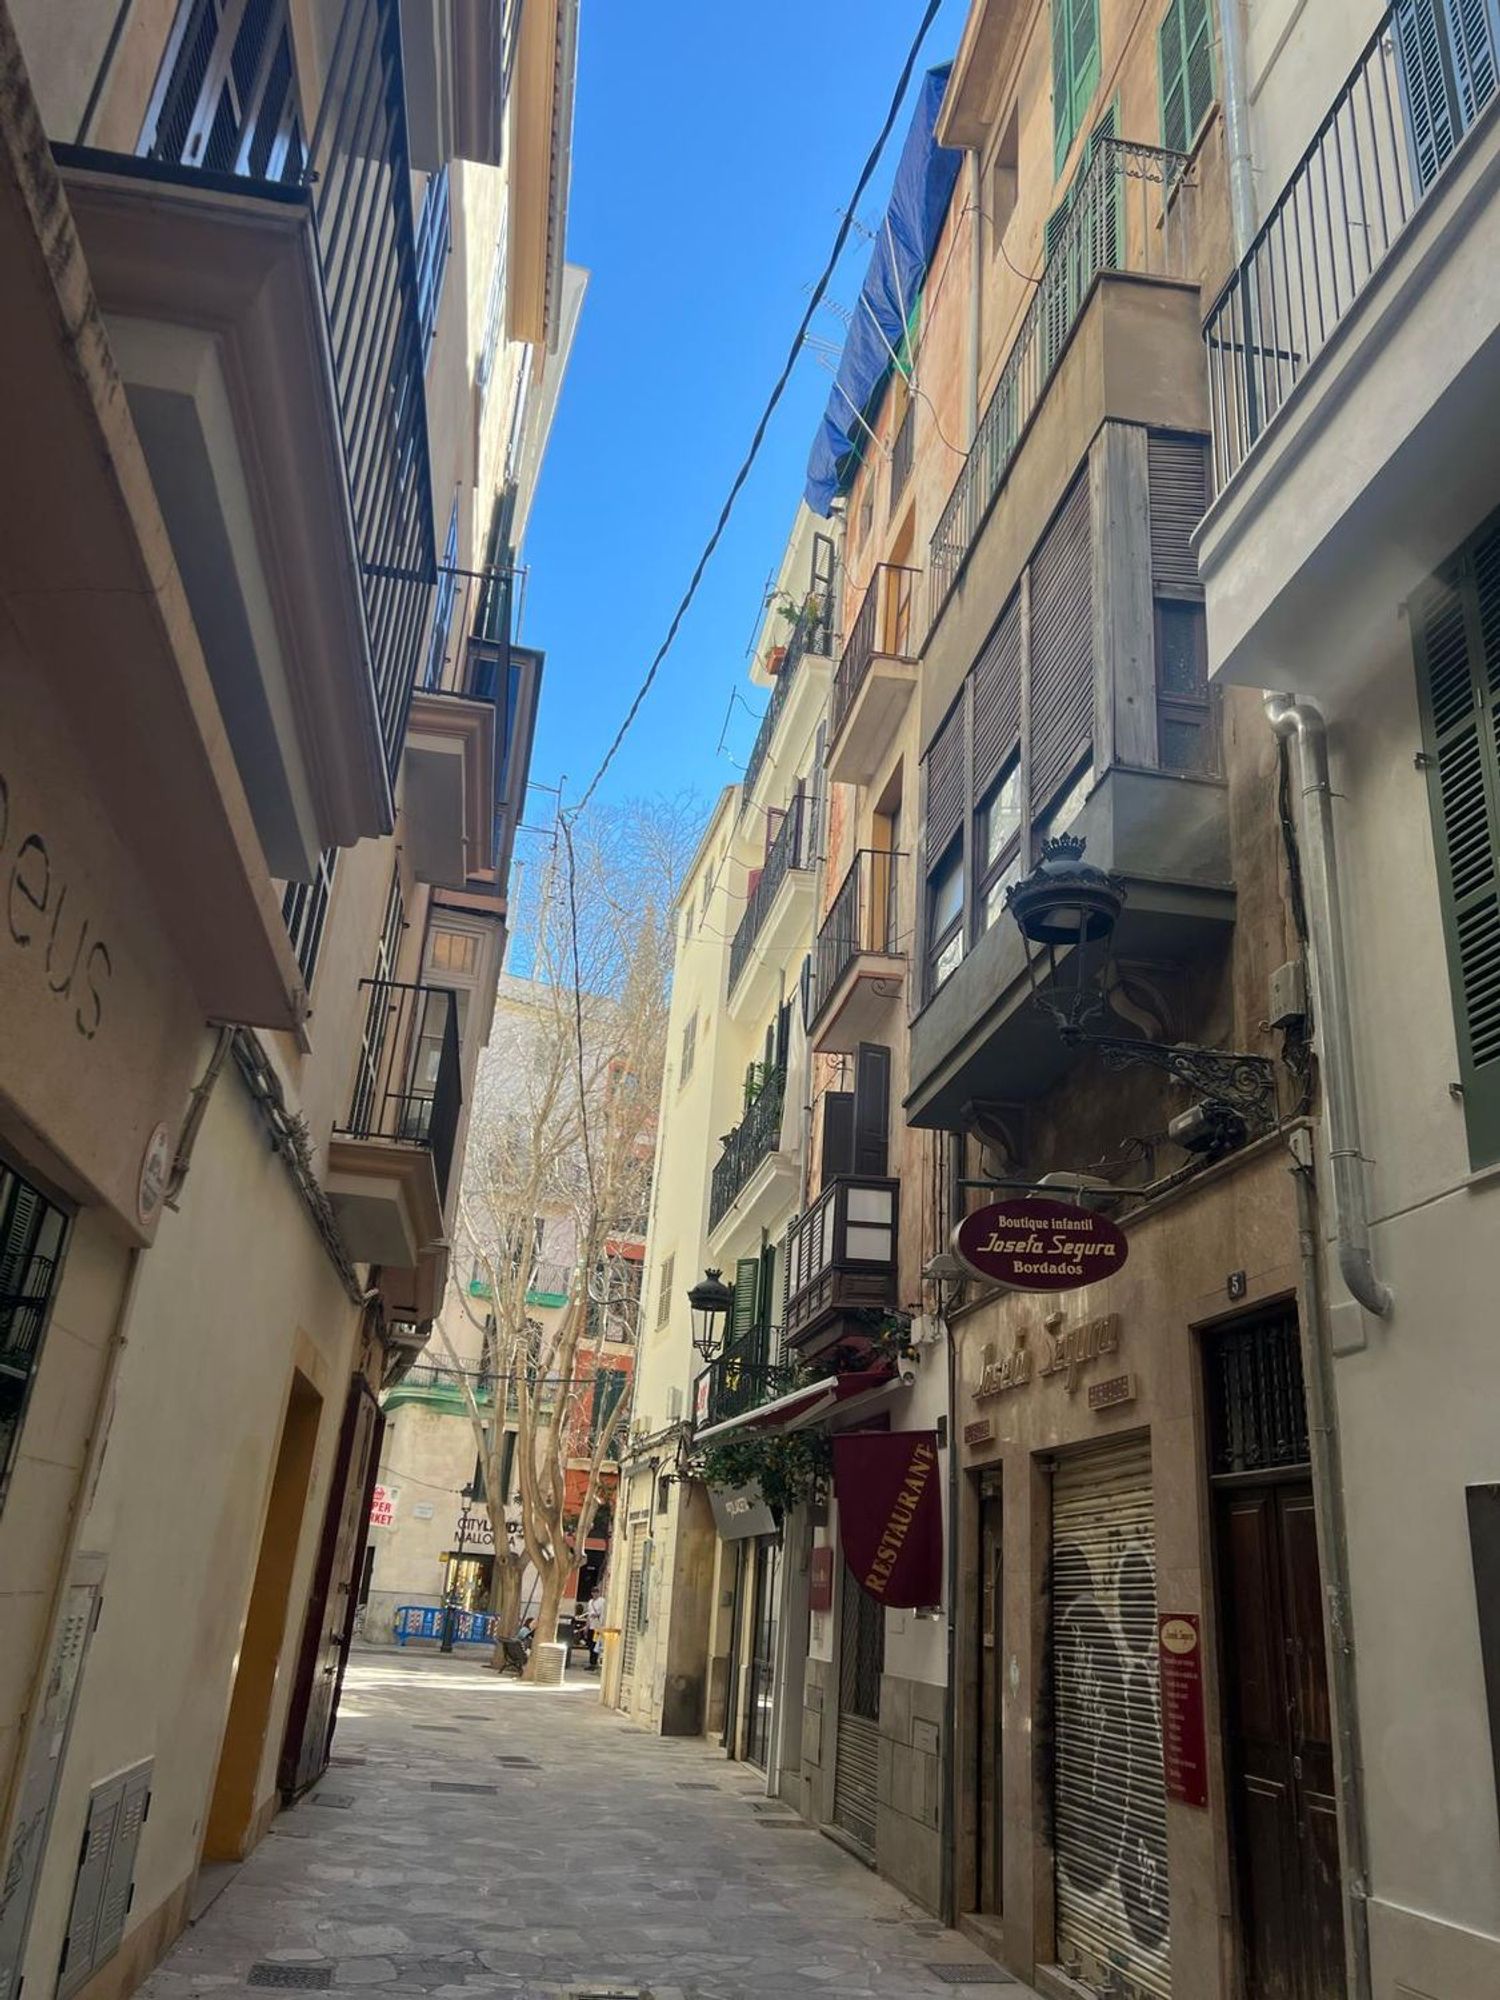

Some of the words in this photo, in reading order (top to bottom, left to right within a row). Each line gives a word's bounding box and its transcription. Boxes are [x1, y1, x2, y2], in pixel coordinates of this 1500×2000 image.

[0, 772, 112, 1041] eus
[998, 1214, 1050, 1232] Boutique
[1051, 1217, 1094, 1232] infantil
[977, 1232, 1045, 1254] Josefa
[1047, 1234, 1116, 1263] Segura
[1012, 1260, 1084, 1276] Bordados
[1231, 1275, 1240, 1295] 5
[1038, 1311, 1119, 1395] Segura
[371, 1500, 392, 1514] PER
[370, 1513, 394, 1526] RKET
[457, 1517, 518, 1534] CITYLD
[864, 1442, 936, 1595] RESTAURANT
[453, 1530, 516, 1548] MALLOA
